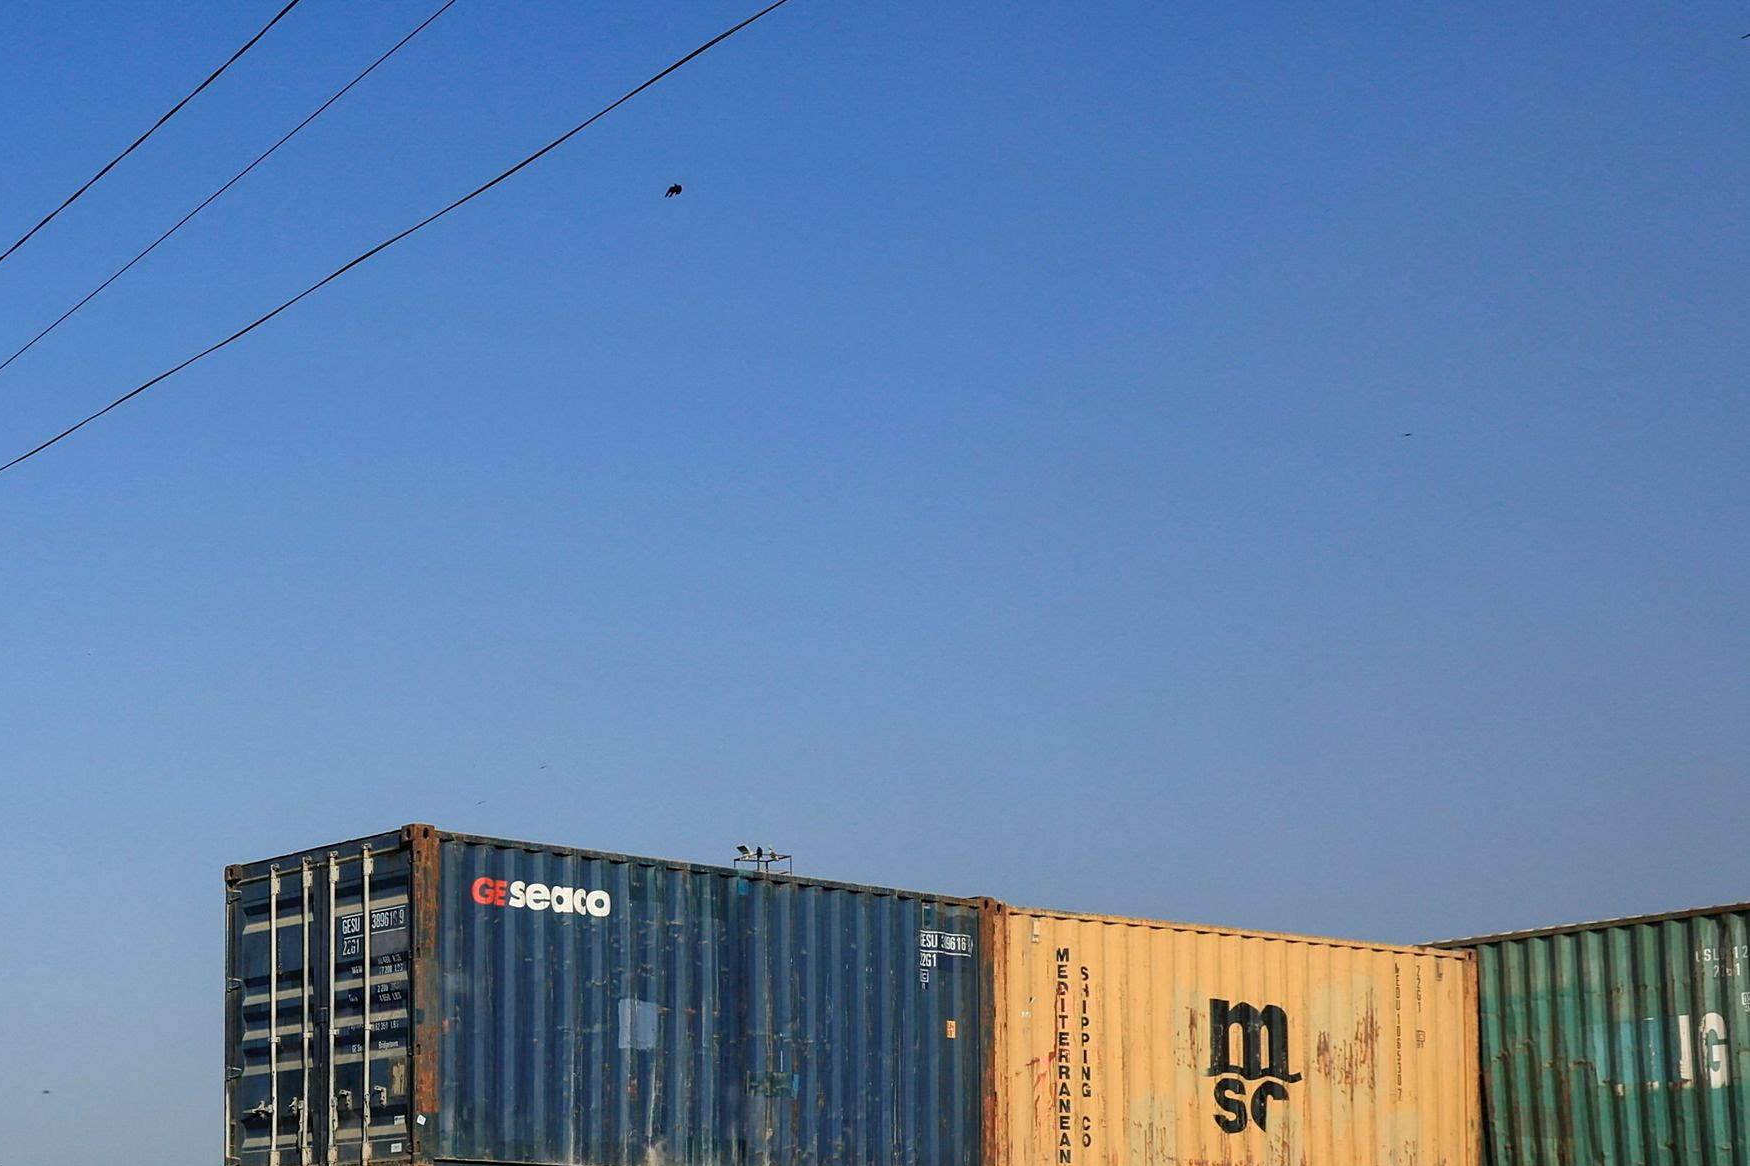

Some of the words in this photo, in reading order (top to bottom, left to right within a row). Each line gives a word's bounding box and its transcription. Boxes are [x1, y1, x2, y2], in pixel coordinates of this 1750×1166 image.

[342, 916, 361, 935] GESU
[398, 908, 405, 924] 9
[1056, 948, 1072, 1164] MEDITERRANEAN
[1081, 1115, 1092, 1148] CO
